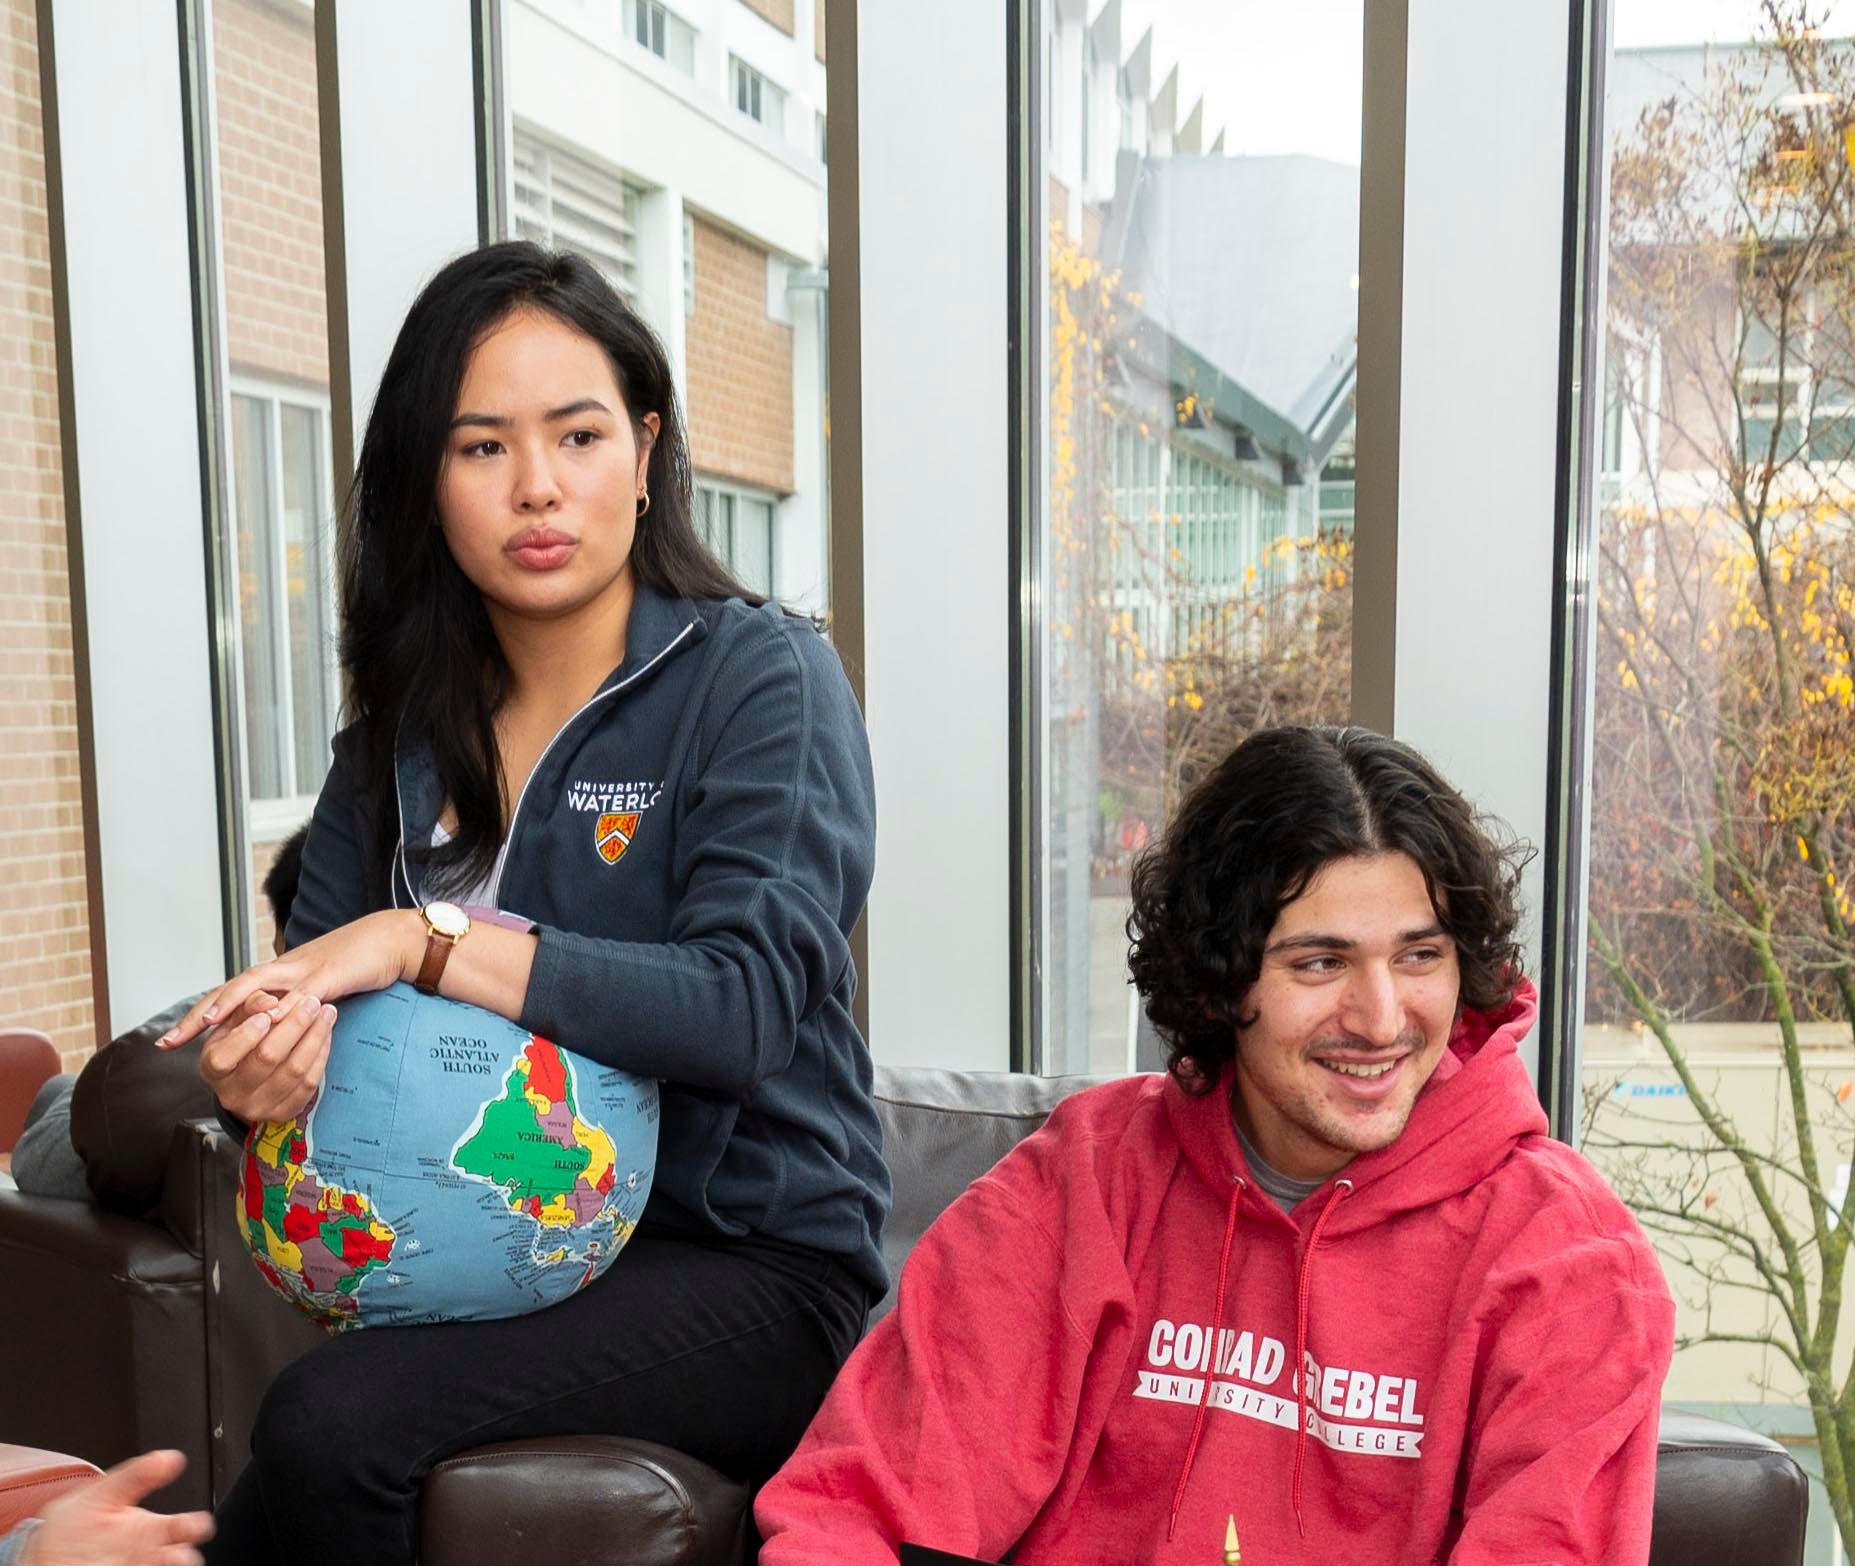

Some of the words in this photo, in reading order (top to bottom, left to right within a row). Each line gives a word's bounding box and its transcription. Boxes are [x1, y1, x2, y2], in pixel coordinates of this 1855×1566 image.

[574, 780, 655, 793] UNIVERSITY
[439, 1036, 488, 1049] OCEAN
[429, 1048, 500, 1063] ATLANTIC
[443, 1061, 492, 1075] SOUTH
[517, 1131, 564, 1144] AMERICA
[553, 1159, 585, 1170] SOUTH
